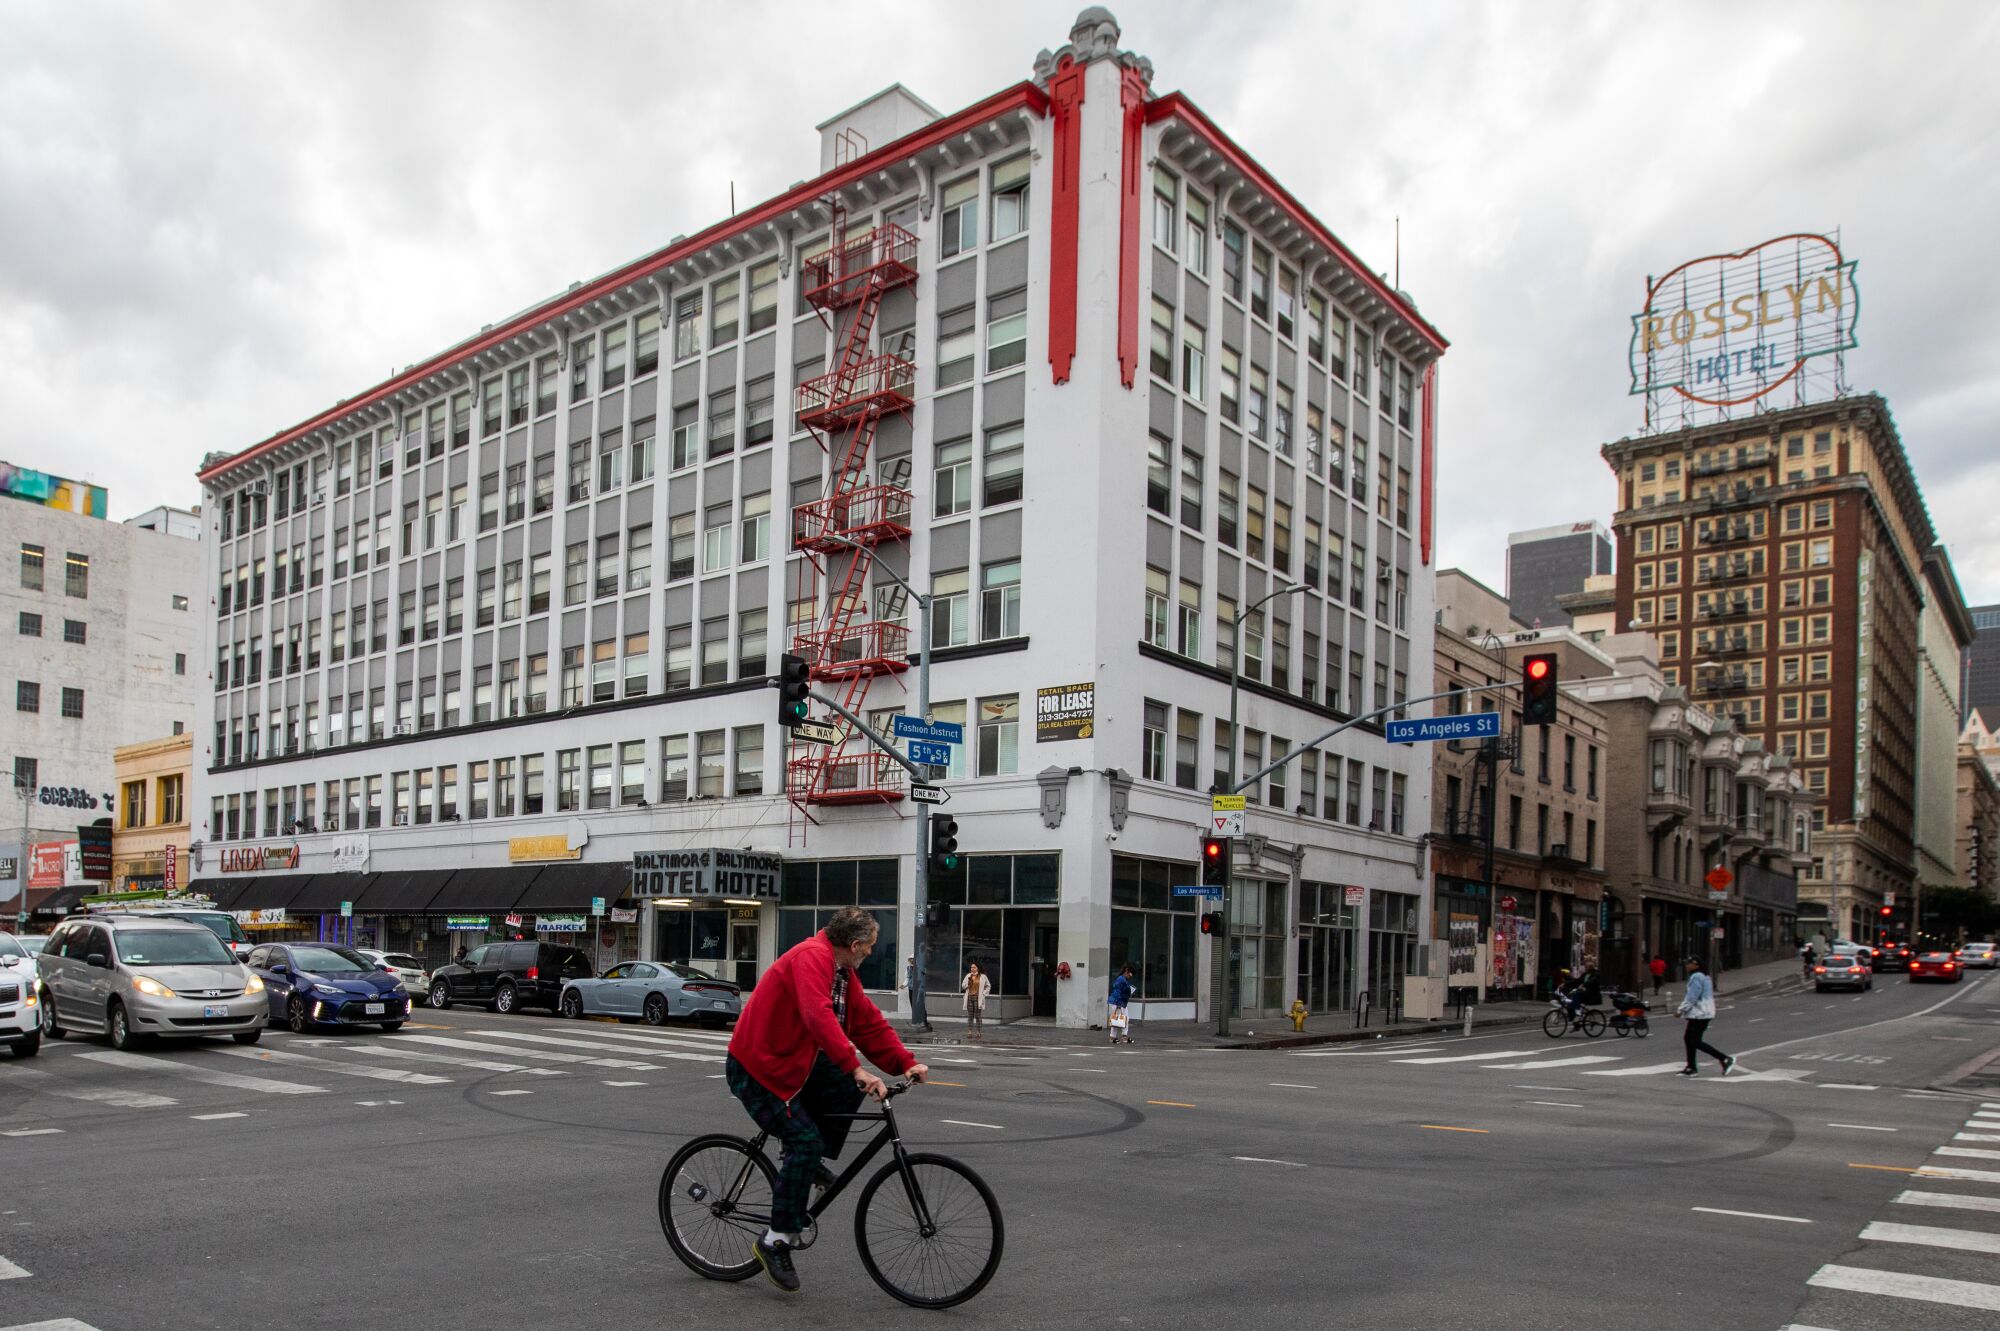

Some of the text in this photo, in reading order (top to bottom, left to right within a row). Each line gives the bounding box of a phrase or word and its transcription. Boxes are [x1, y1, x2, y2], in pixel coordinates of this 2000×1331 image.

[1641, 271, 1842, 353] ROSSLYN
[1696, 343, 1786, 385] HOTEL
[1039, 683, 1094, 696] RETAIL SPACE
[1856, 559, 1870, 815] HOTEL ROSSLYN
[1038, 691, 1093, 714] FOR LEASE
[1038, 709, 1093, 722] 213-304-4727
[816, 727, 834, 740] WAY
[898, 722, 958, 739] Fashion District
[1393, 718, 1492, 738] Los Angeles St
[912, 744, 932, 759] 5th
[914, 788, 939, 799] ONE WAY
[221, 846, 294, 872] LINDA Company
[634, 853, 710, 870] BALTIMORE
[716, 852, 780, 872] BALTIMORE
[634, 871, 708, 894] HOTEL
[715, 870, 779, 897] HOTEL
[507, 914, 522, 927] ATM
[738, 910, 754, 918] 501
[537, 923, 586, 931] MARKET
